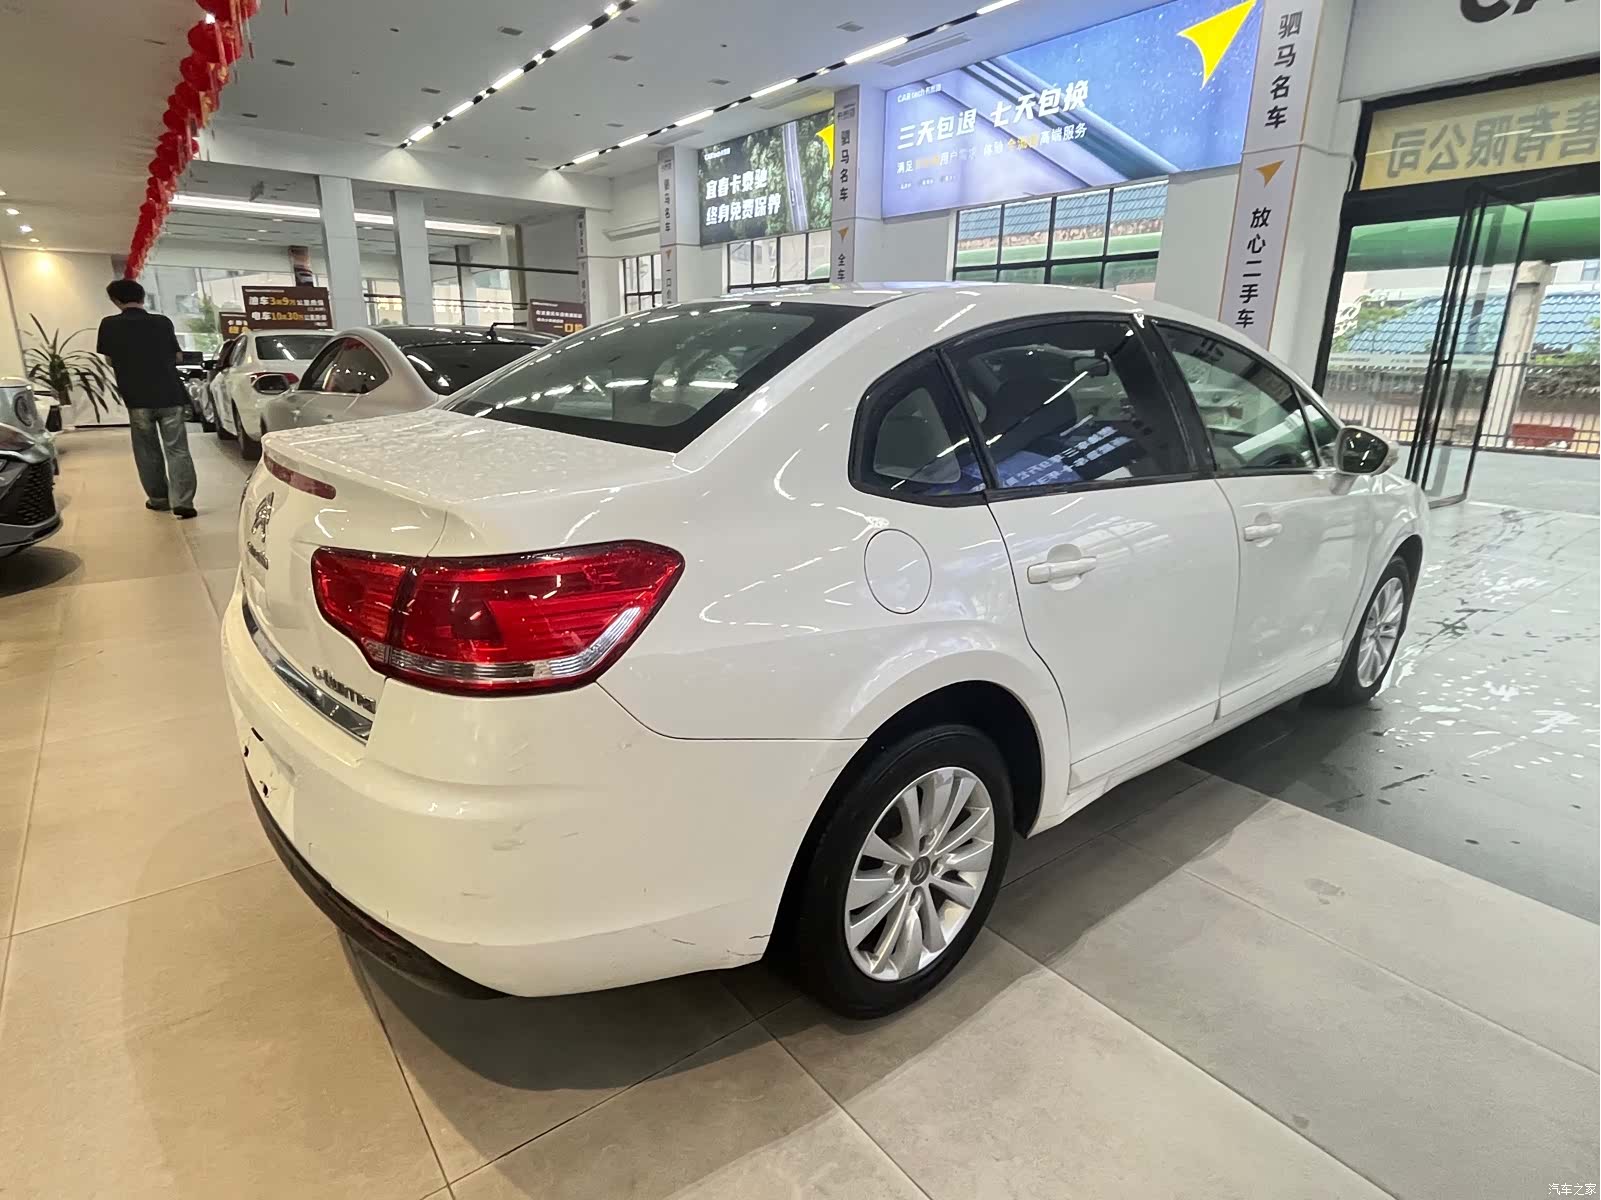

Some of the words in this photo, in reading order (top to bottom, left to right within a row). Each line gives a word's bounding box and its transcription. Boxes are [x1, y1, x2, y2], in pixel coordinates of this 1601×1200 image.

[897, 108, 977, 150] 三天包退
[990, 79, 1089, 128] 七天包换
[1264, 11, 1303, 129] 驷马名车
[705, 193, 781, 226] 终身免费保养
[1235, 207, 1271, 328] 放心二手车
